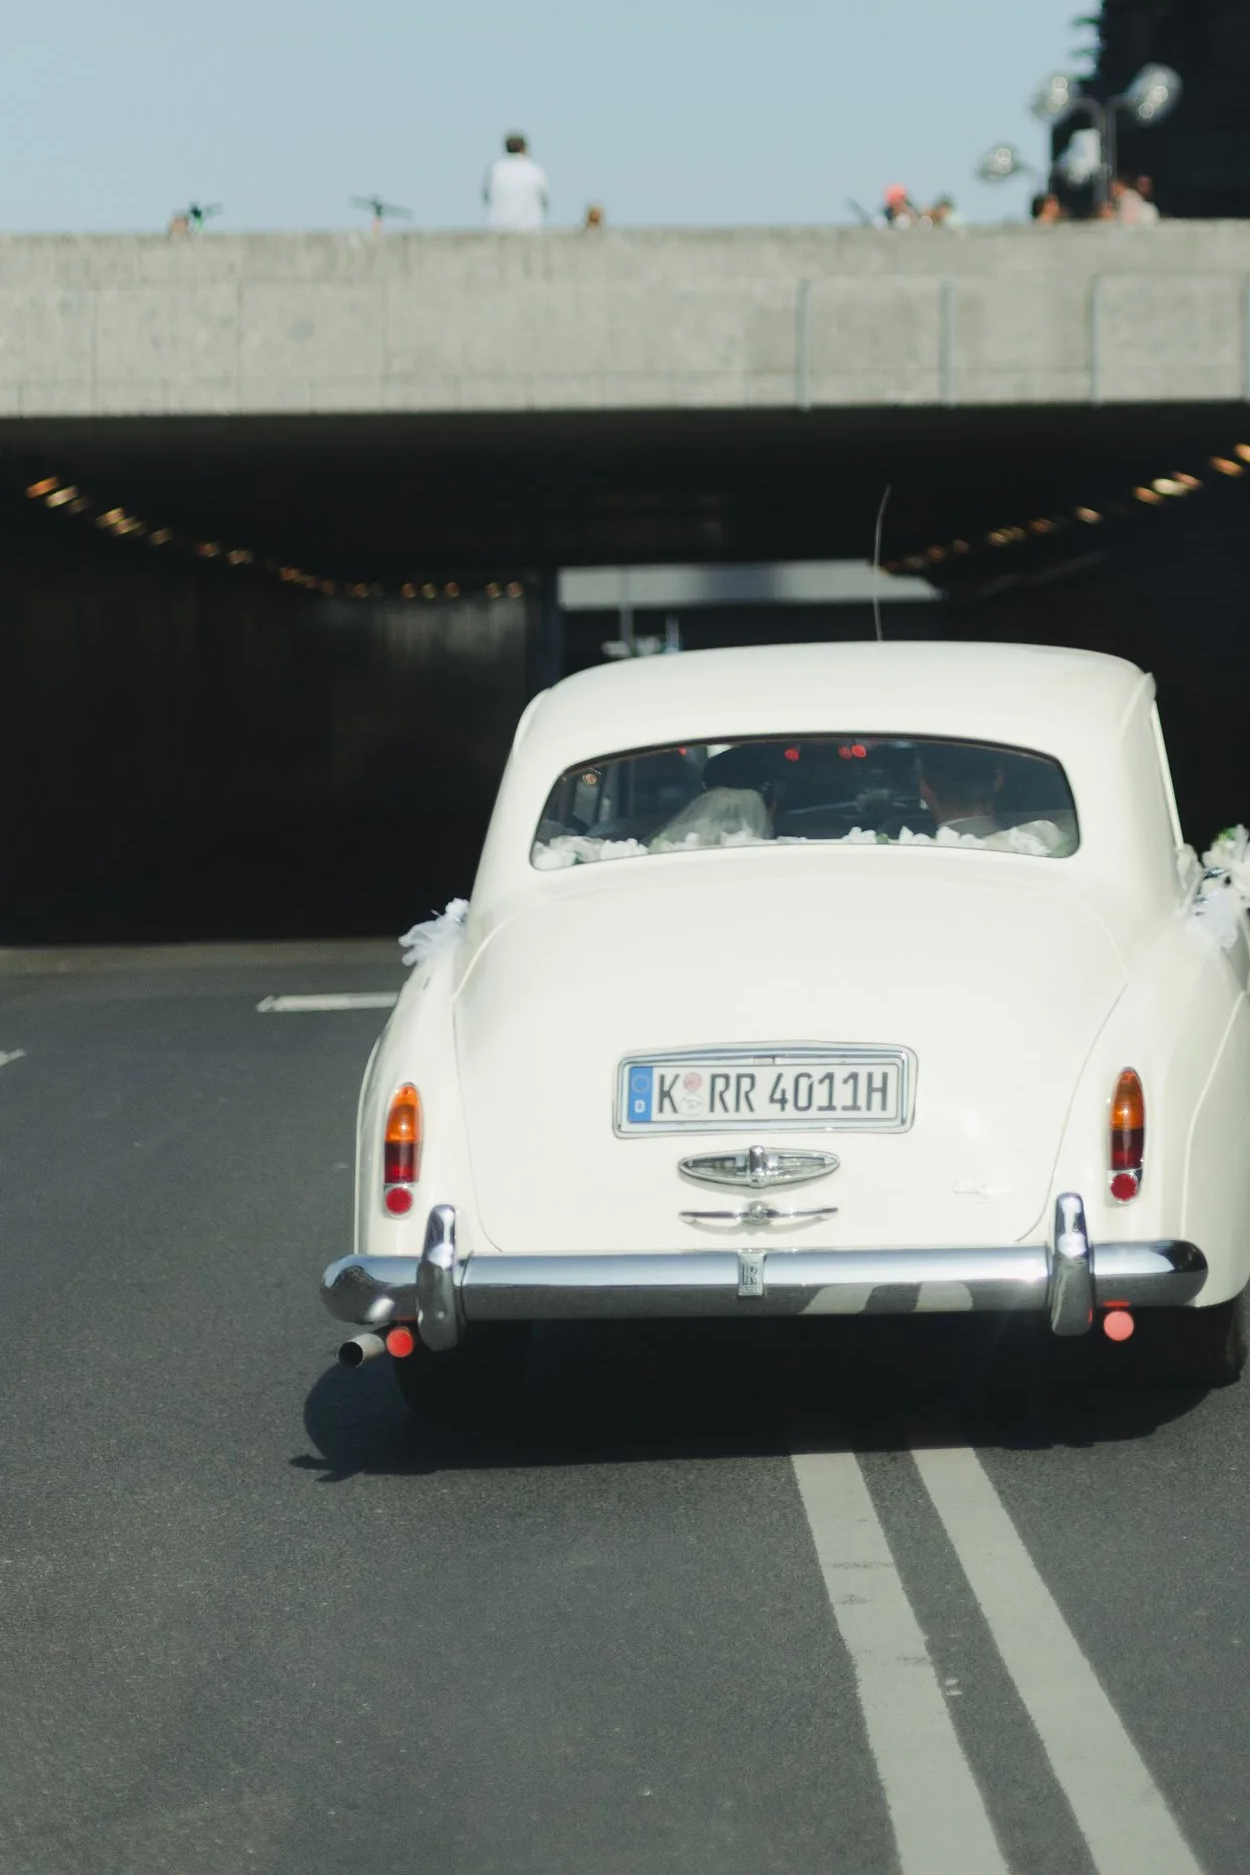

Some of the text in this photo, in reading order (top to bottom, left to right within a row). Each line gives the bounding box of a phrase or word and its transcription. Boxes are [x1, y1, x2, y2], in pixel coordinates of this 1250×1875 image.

[634, 1100, 646, 1113] D
[658, 1071, 888, 1114] K RR 4011H
